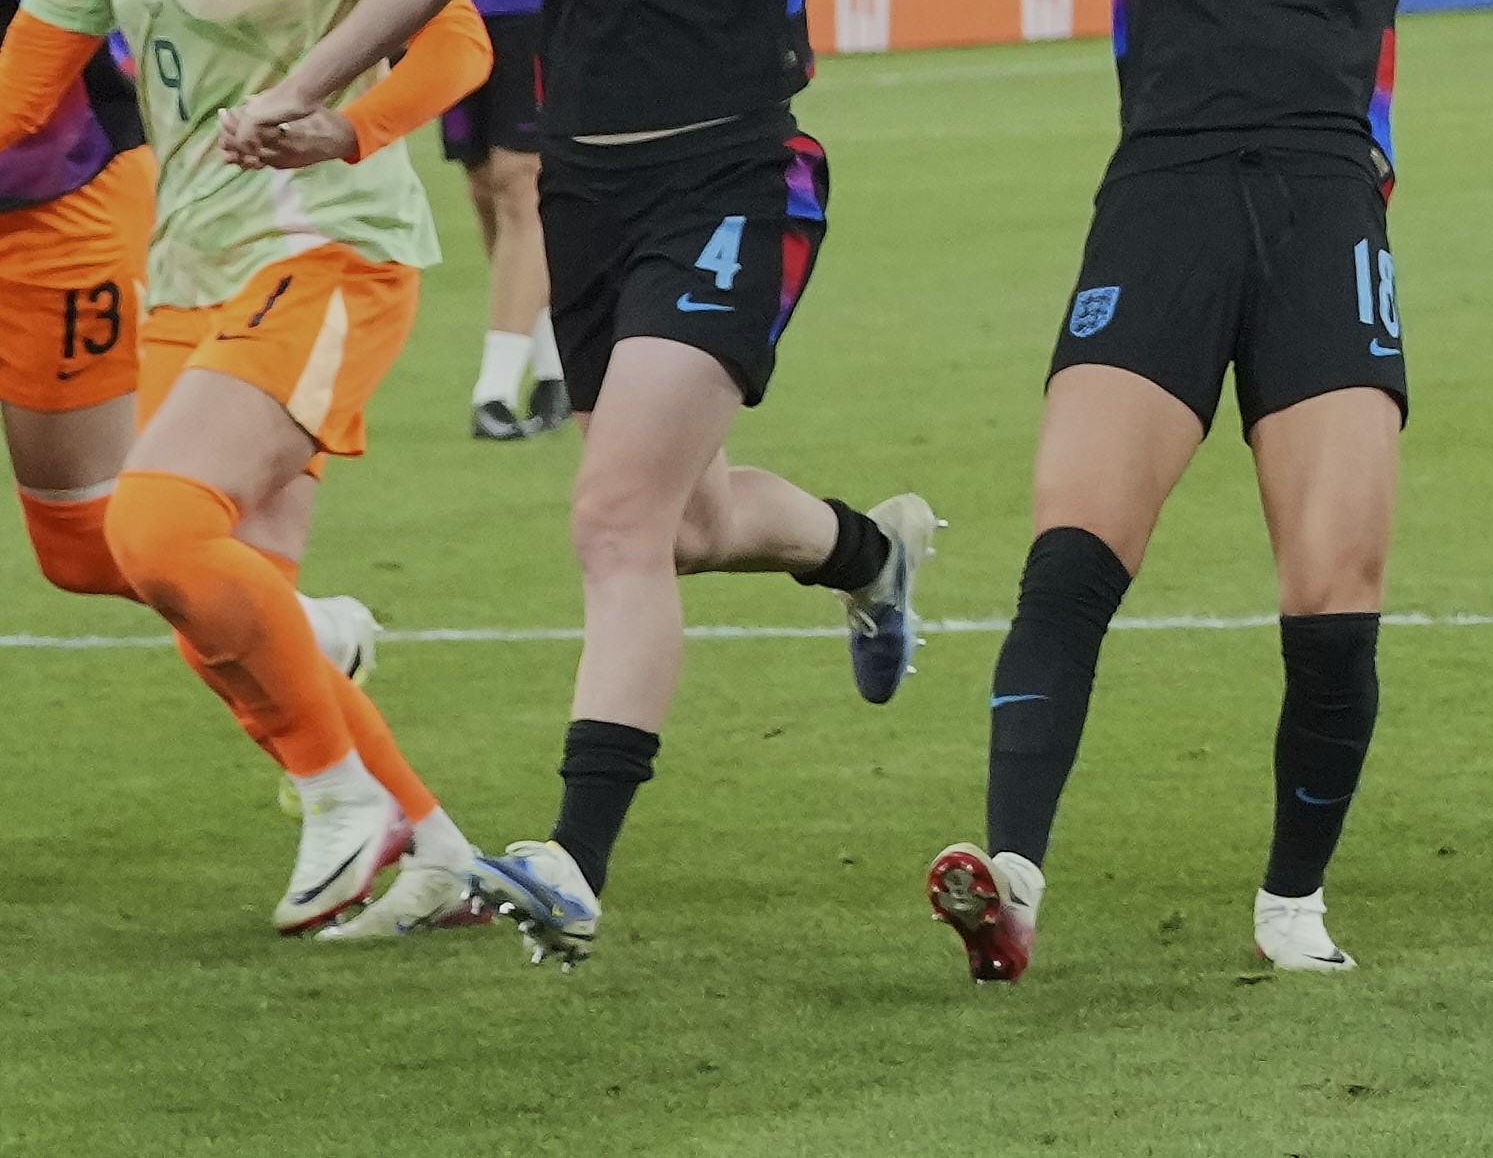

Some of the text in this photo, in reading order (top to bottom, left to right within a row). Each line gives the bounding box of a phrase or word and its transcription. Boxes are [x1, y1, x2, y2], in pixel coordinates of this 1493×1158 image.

[153, 39, 190, 122] 9
[694, 215, 747, 290] 4
[1353, 238, 1400, 339] 18
[63, 280, 122, 358] 13
